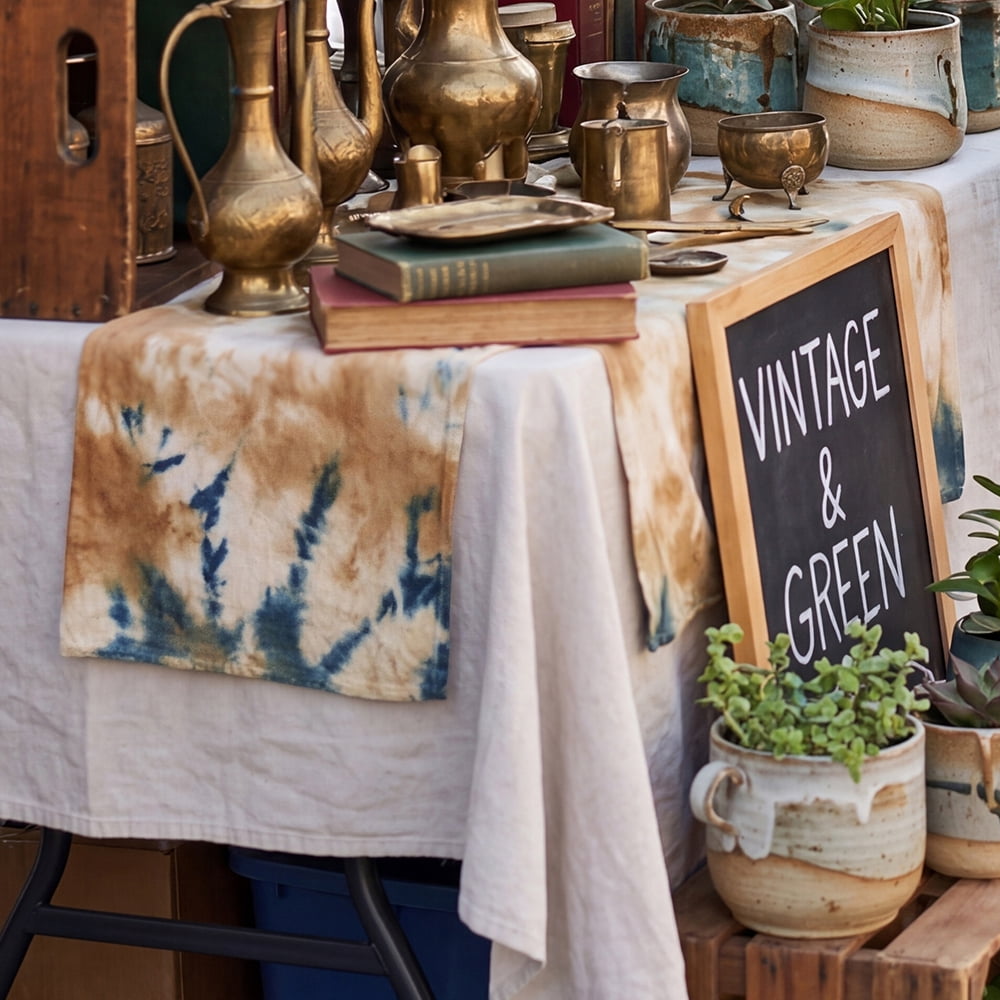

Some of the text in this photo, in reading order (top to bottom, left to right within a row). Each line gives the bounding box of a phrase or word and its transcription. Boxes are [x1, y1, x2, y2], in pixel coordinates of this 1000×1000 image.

[738, 308, 891, 462] VINTAGE
[819, 446, 847, 529] &
[784, 505, 906, 665] GREEN
